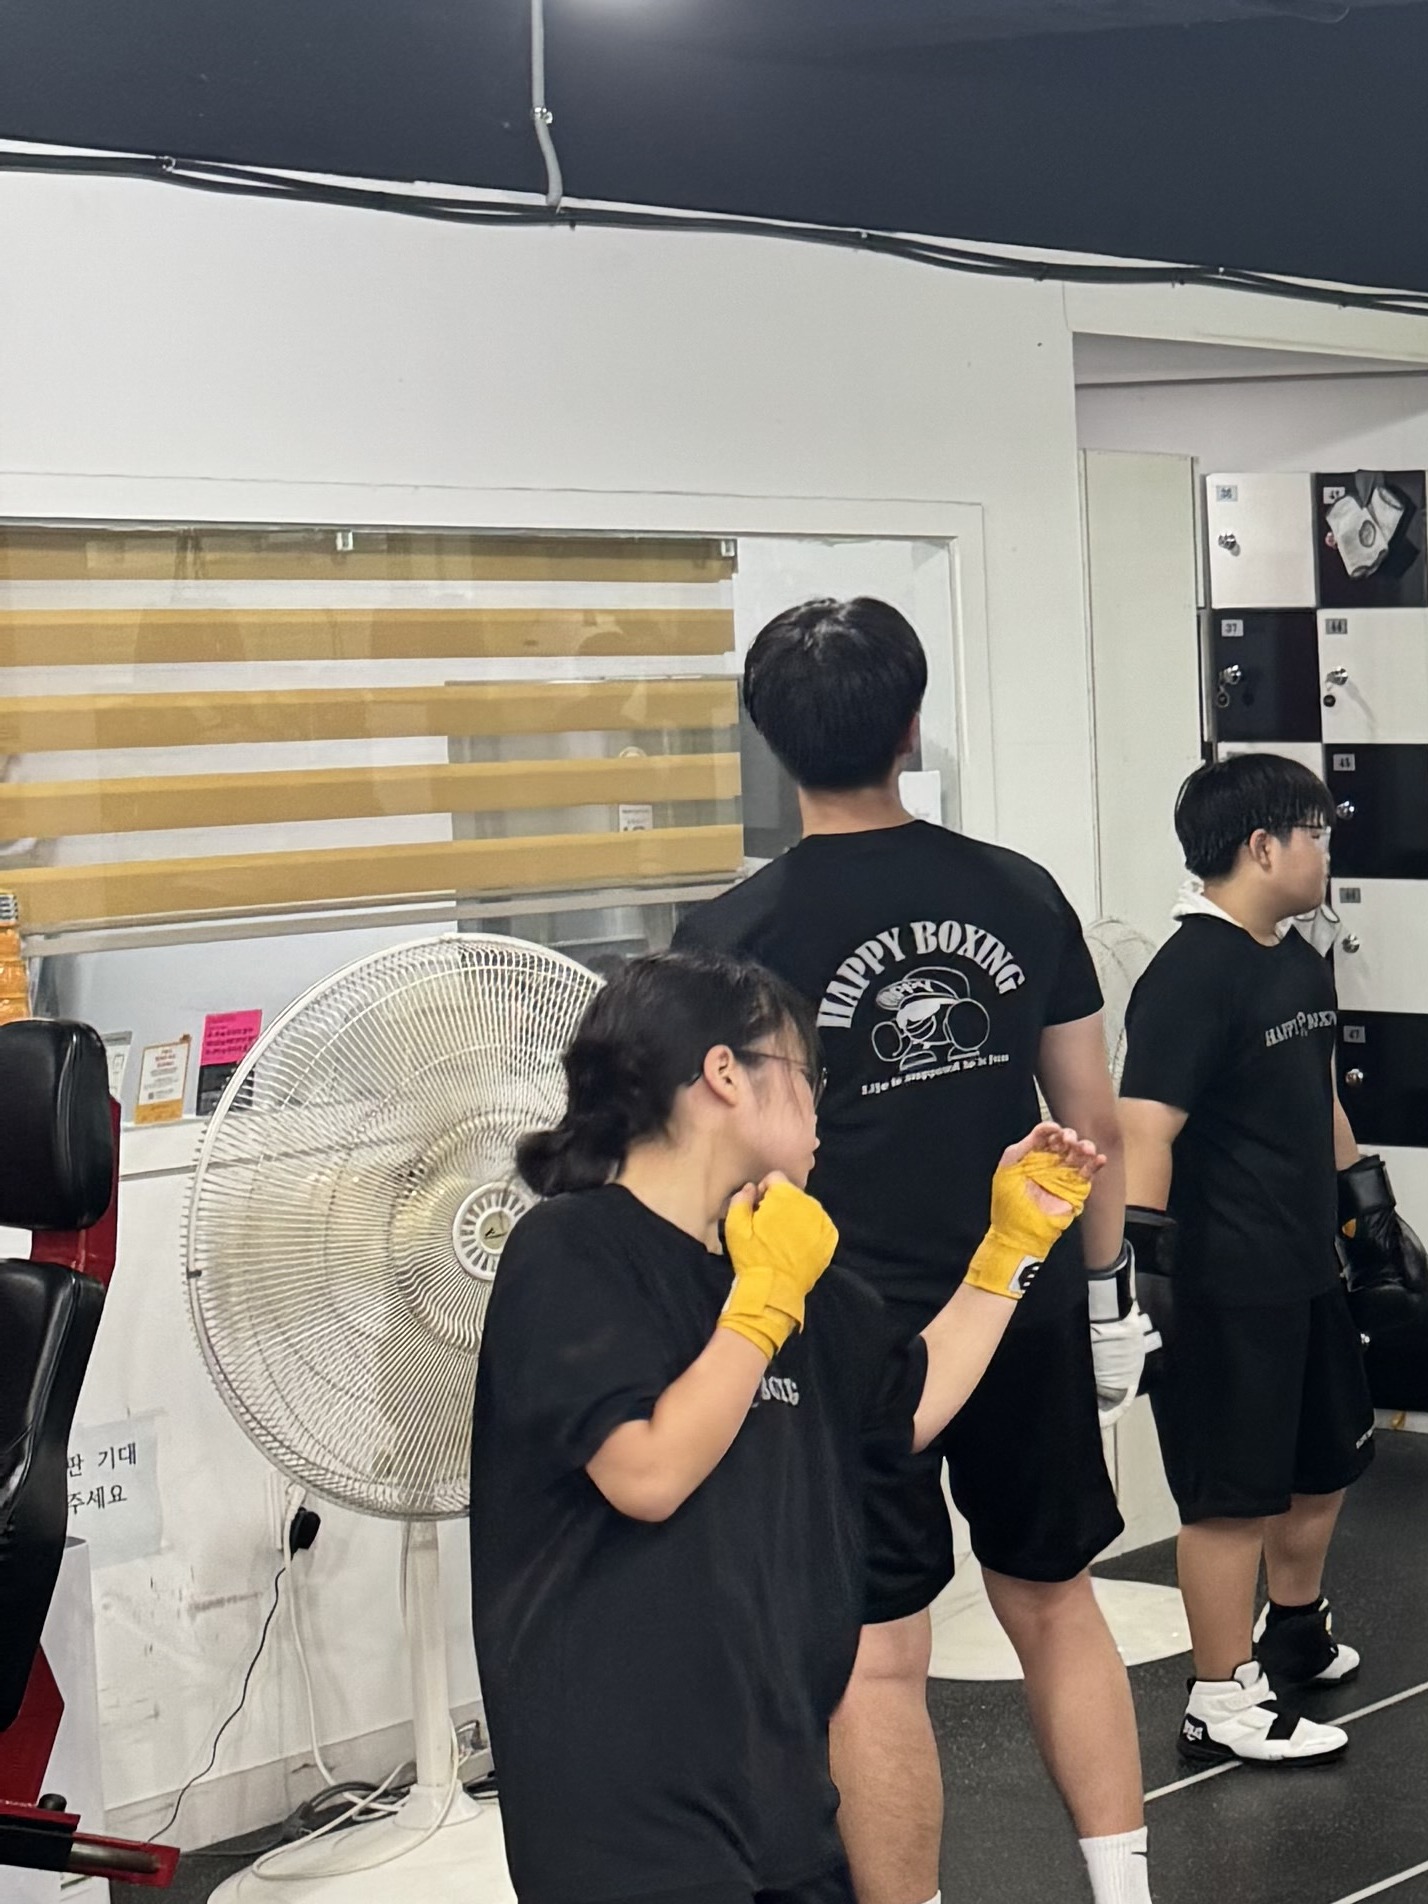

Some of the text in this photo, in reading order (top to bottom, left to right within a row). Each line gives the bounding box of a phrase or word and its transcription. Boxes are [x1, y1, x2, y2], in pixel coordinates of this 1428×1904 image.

[816, 920, 1026, 1029] HAPPY BOXING
[98, 1442, 136, 1470] 기대
[68, 1484, 128, 1515] 주세요
